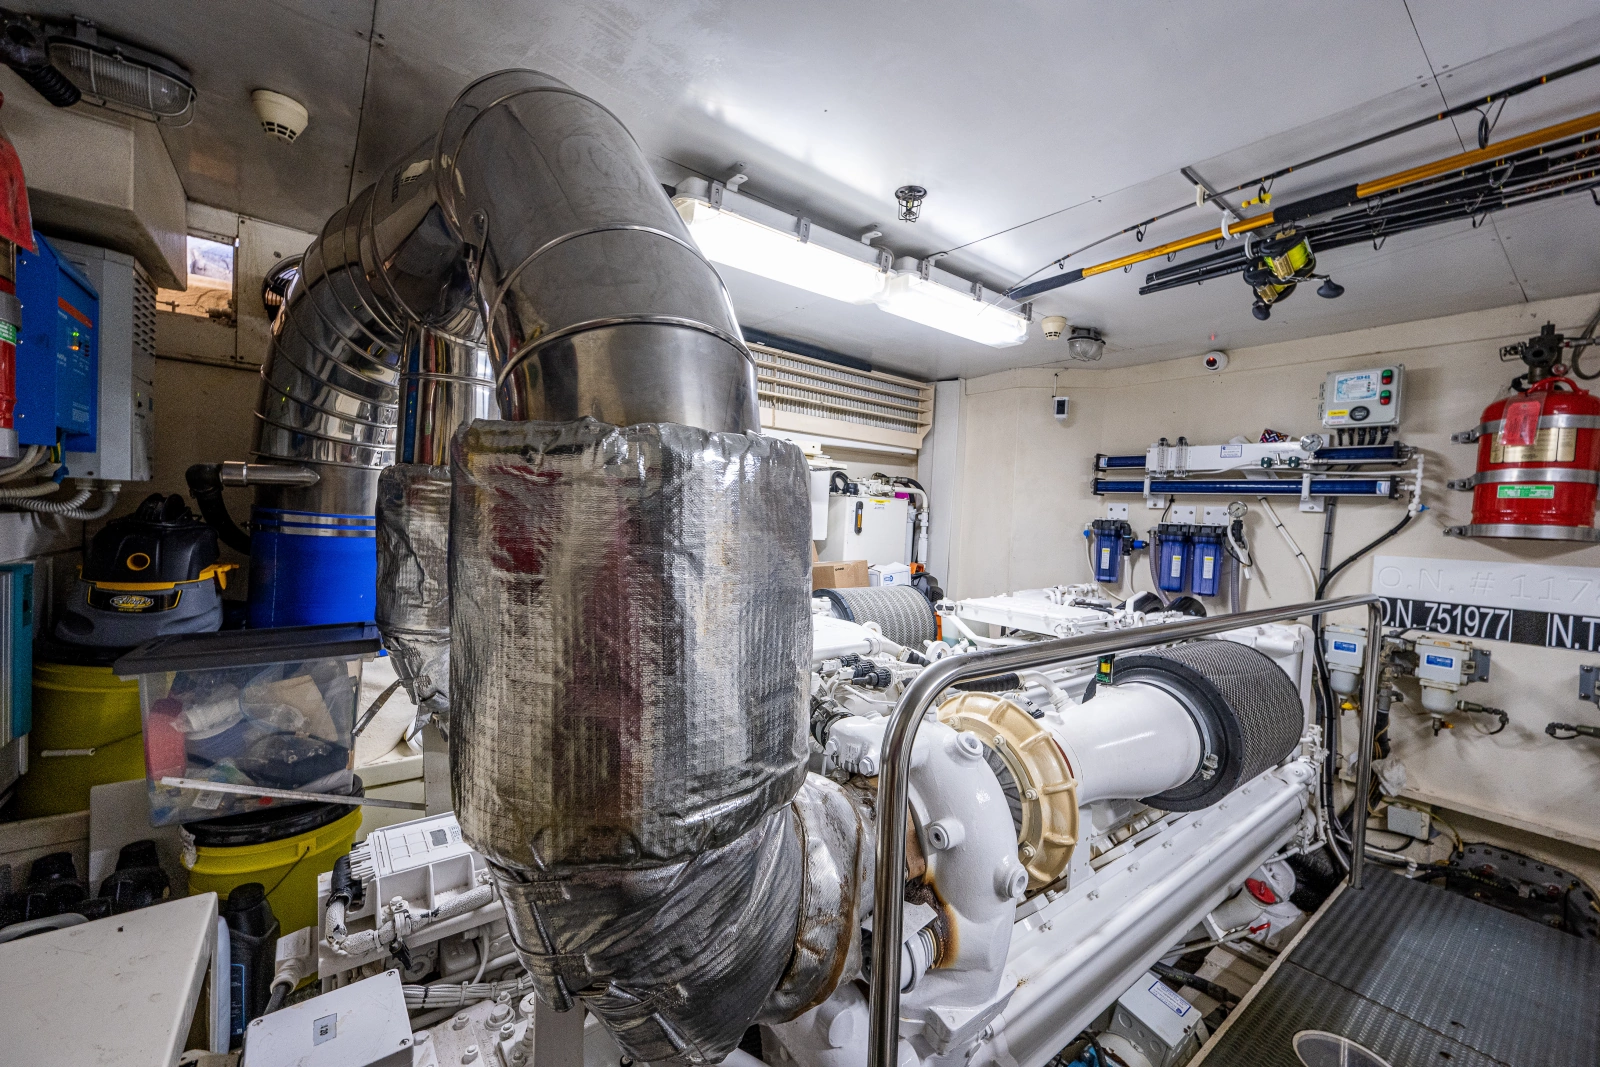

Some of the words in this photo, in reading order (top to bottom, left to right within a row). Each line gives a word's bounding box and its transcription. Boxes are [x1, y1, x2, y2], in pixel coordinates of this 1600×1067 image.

[1470, 571, 1495, 596] #
[1510, 574, 1600, 604] 117
[1424, 602, 1510, 640] 751977
